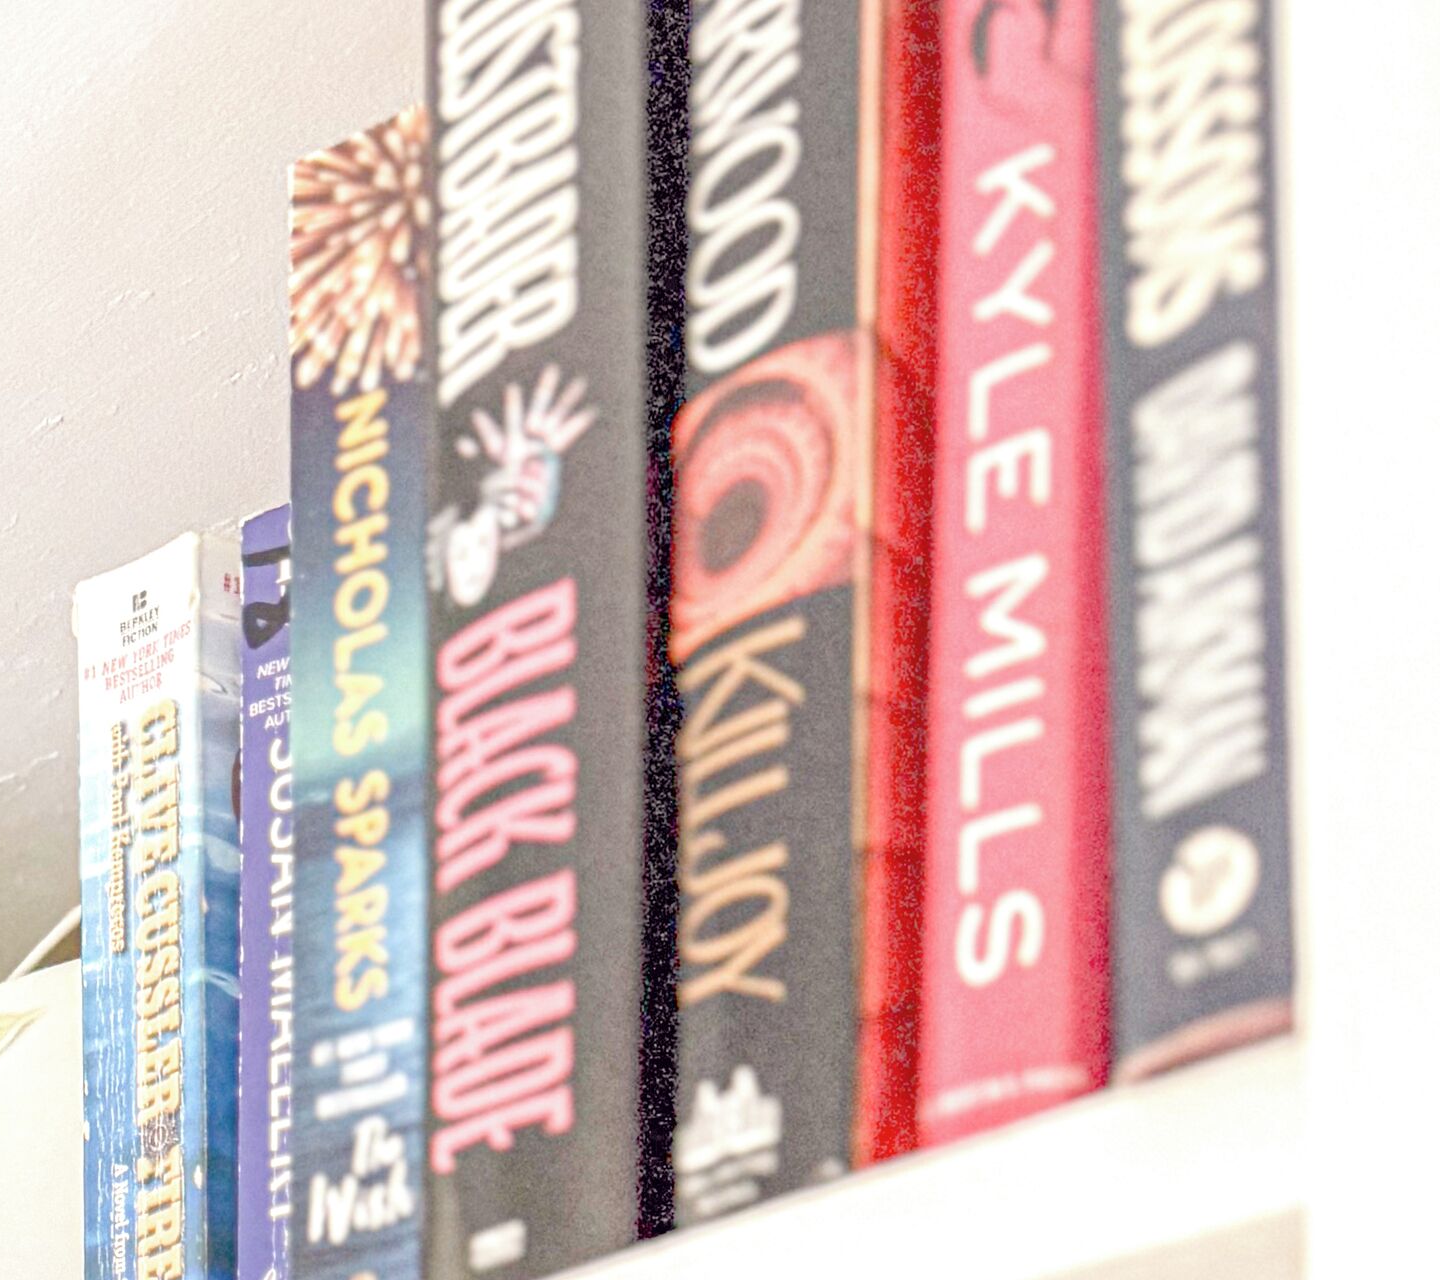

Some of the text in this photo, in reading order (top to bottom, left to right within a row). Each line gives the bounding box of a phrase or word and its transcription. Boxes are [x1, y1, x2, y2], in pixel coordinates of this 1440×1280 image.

[972, 142, 1056, 535] KYLE
[103, 654, 127, 674] NEW
[133, 643, 159, 662] YORK
[163, 620, 192, 649] TIMES
[105, 648, 175, 691] BESTSELLING
[119, 672, 163, 704] AUTHOR
[122, 623, 159, 647] FICTION
[257, 656, 291, 680] NEW
[331, 389, 391, 758] NICHOLAS
[331, 766, 392, 1013] SPARKS
[434, 577, 578, 896] BLACK
[676, 617, 807, 1005] KILLJOY
[957, 552, 1051, 987] MILLS
[135, 698, 183, 1126] CLIVE CUSSLER
[430, 868, 577, 1175] BLADE
